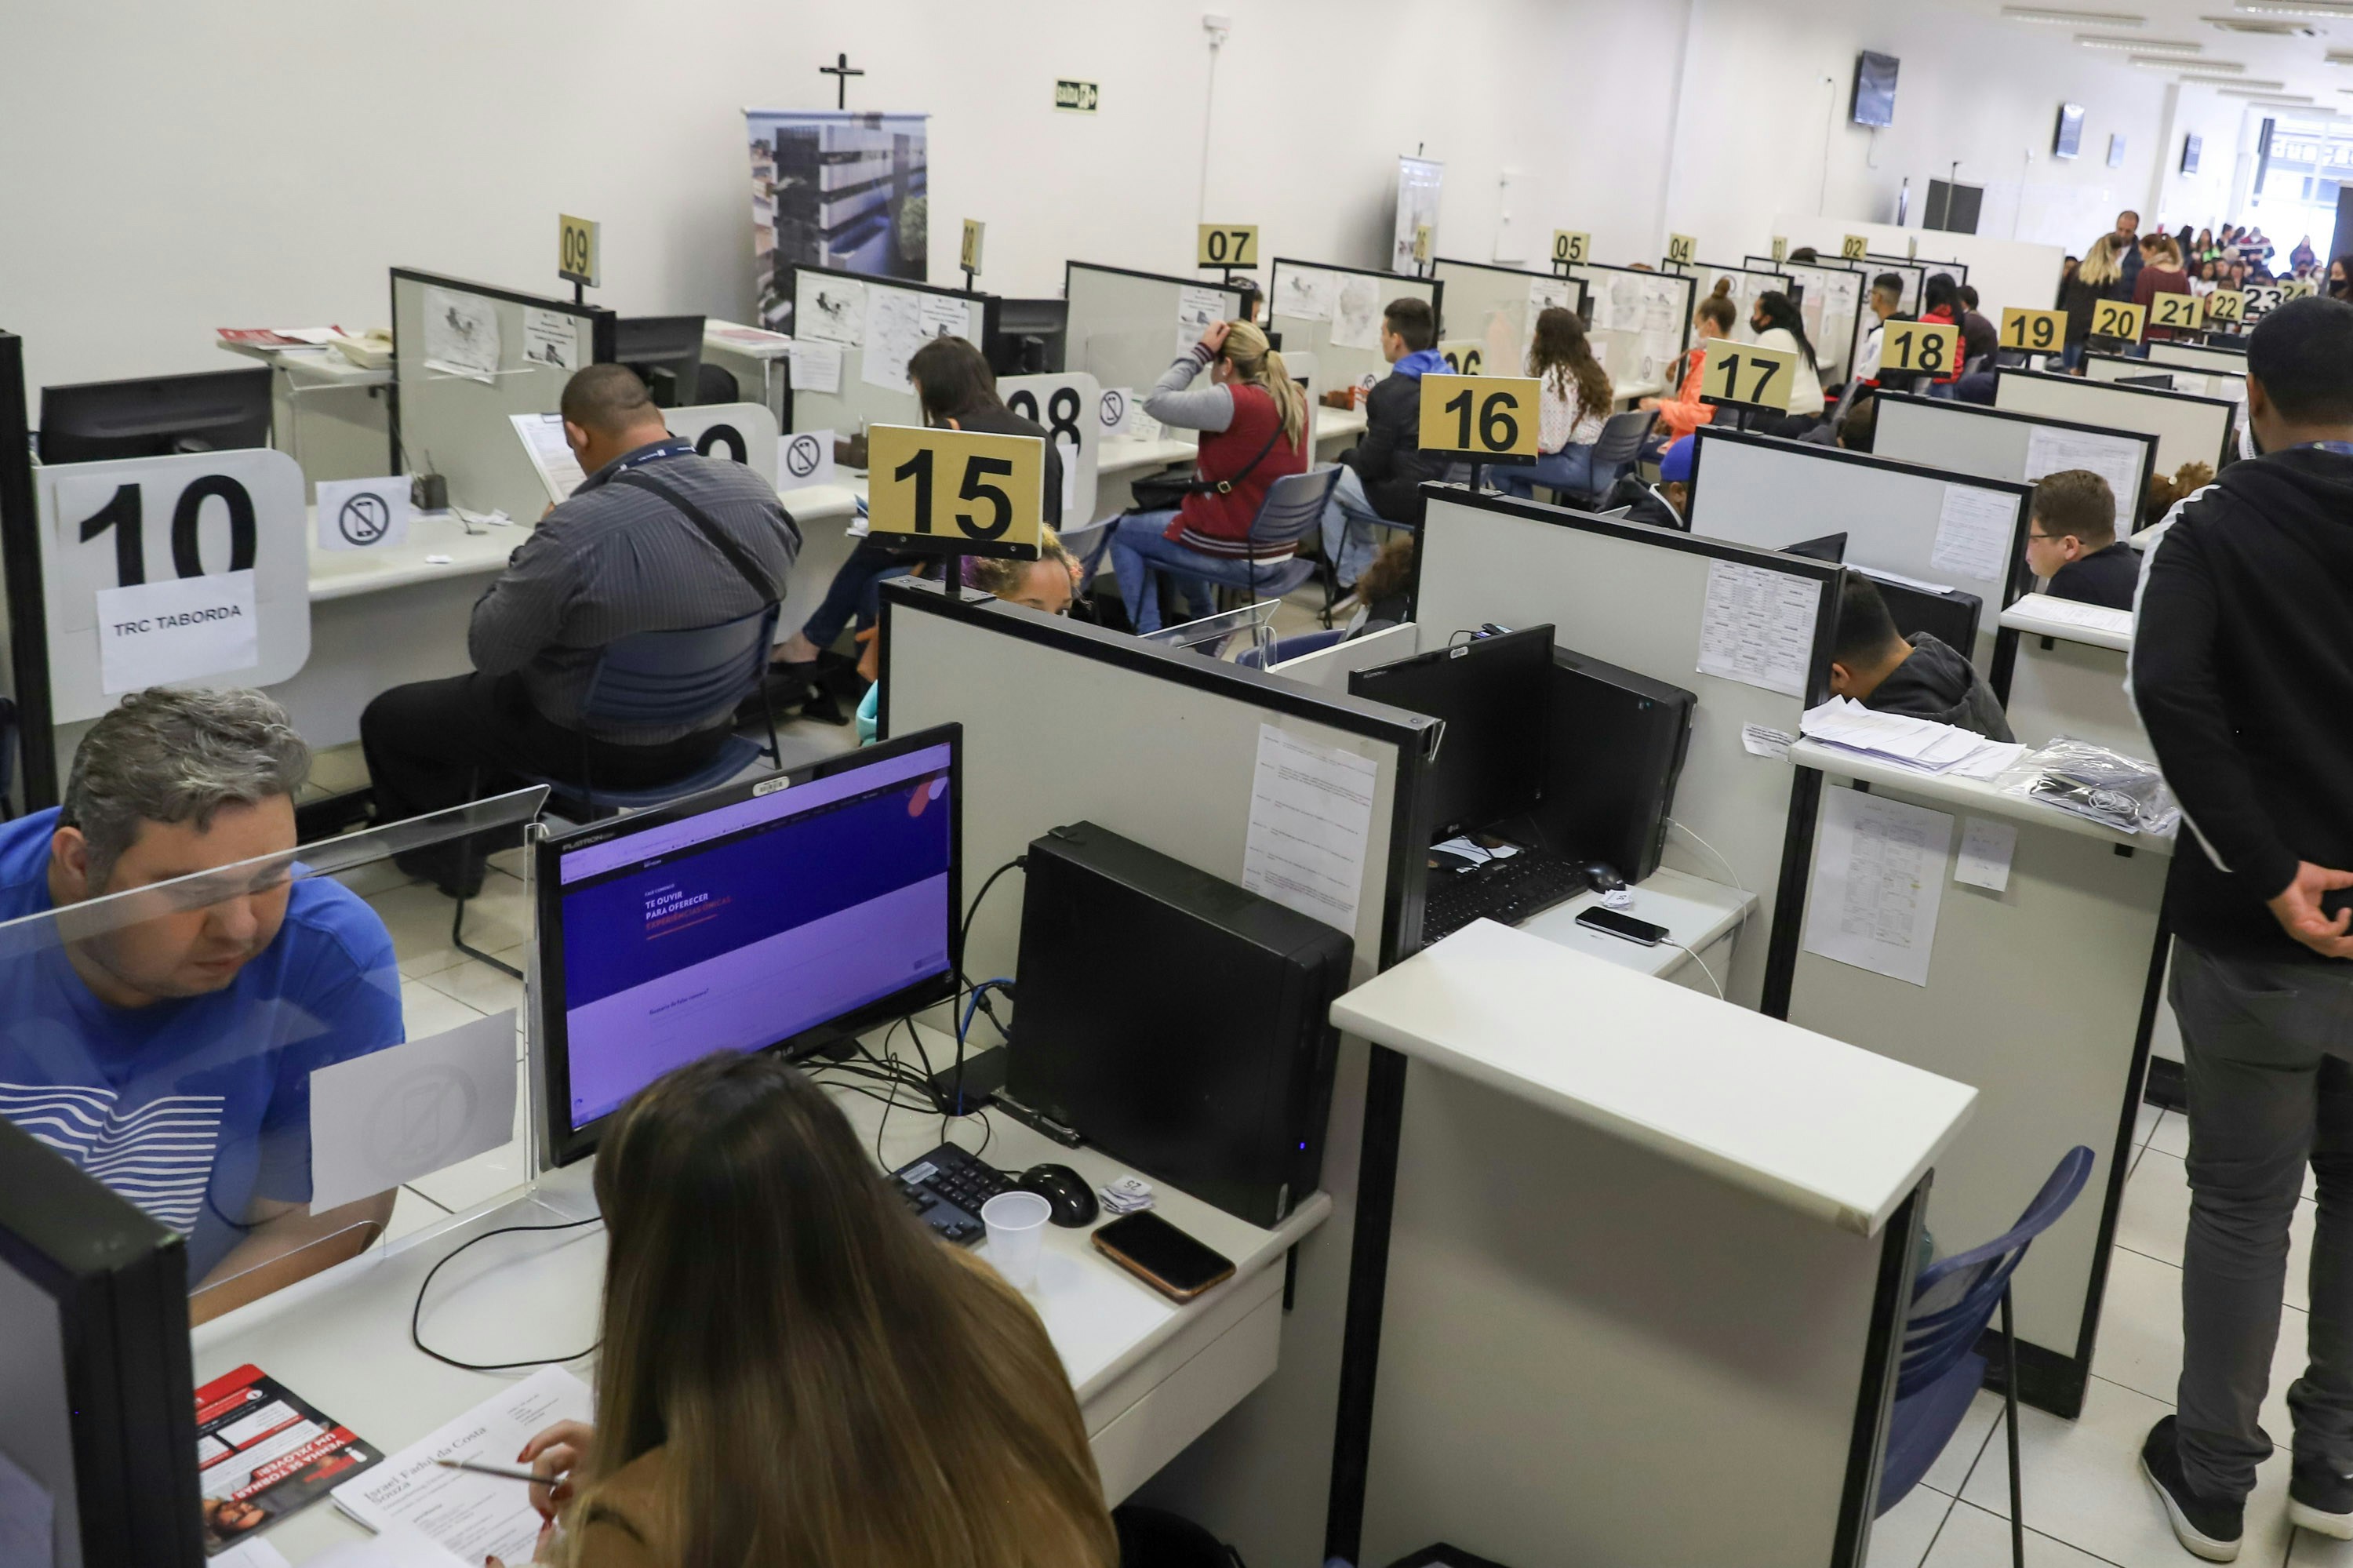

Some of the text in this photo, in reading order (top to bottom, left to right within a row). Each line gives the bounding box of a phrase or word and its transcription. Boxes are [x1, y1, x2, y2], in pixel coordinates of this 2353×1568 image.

[564, 226, 587, 275] 09
[1208, 230, 1251, 262] 07
[1557, 235, 1582, 260] 05
[1671, 238, 1689, 260] 04
[1845, 238, 1863, 256] 02
[2160, 300, 2195, 326] 21
[2216, 296, 2238, 318] 22
[2244, 288, 2282, 311] 23
[2010, 315, 2054, 347] 19
[2099, 307, 2134, 337] 20
[1894, 331, 1944, 371] 18
[1718, 353, 1780, 403] 17
[1446, 389, 1518, 452] 16
[895, 449, 1013, 540] 15
[79, 475, 257, 588] 10
[114, 604, 243, 637] TRC TABORDA
[646, 891, 683, 909] TE OUVIR
[646, 893, 709, 921] PARA OFERECER
[1123, 1180, 1143, 1191] 25
[314, 1432, 337, 1447] UM
[236, 1439, 346, 1500] VENHA SE TORNAR
[364, 1477, 401, 1500] Israel
[437, 1446, 453, 1459] da
[452, 1426, 487, 1449] Costa
[370, 1481, 411, 1505] Souza
